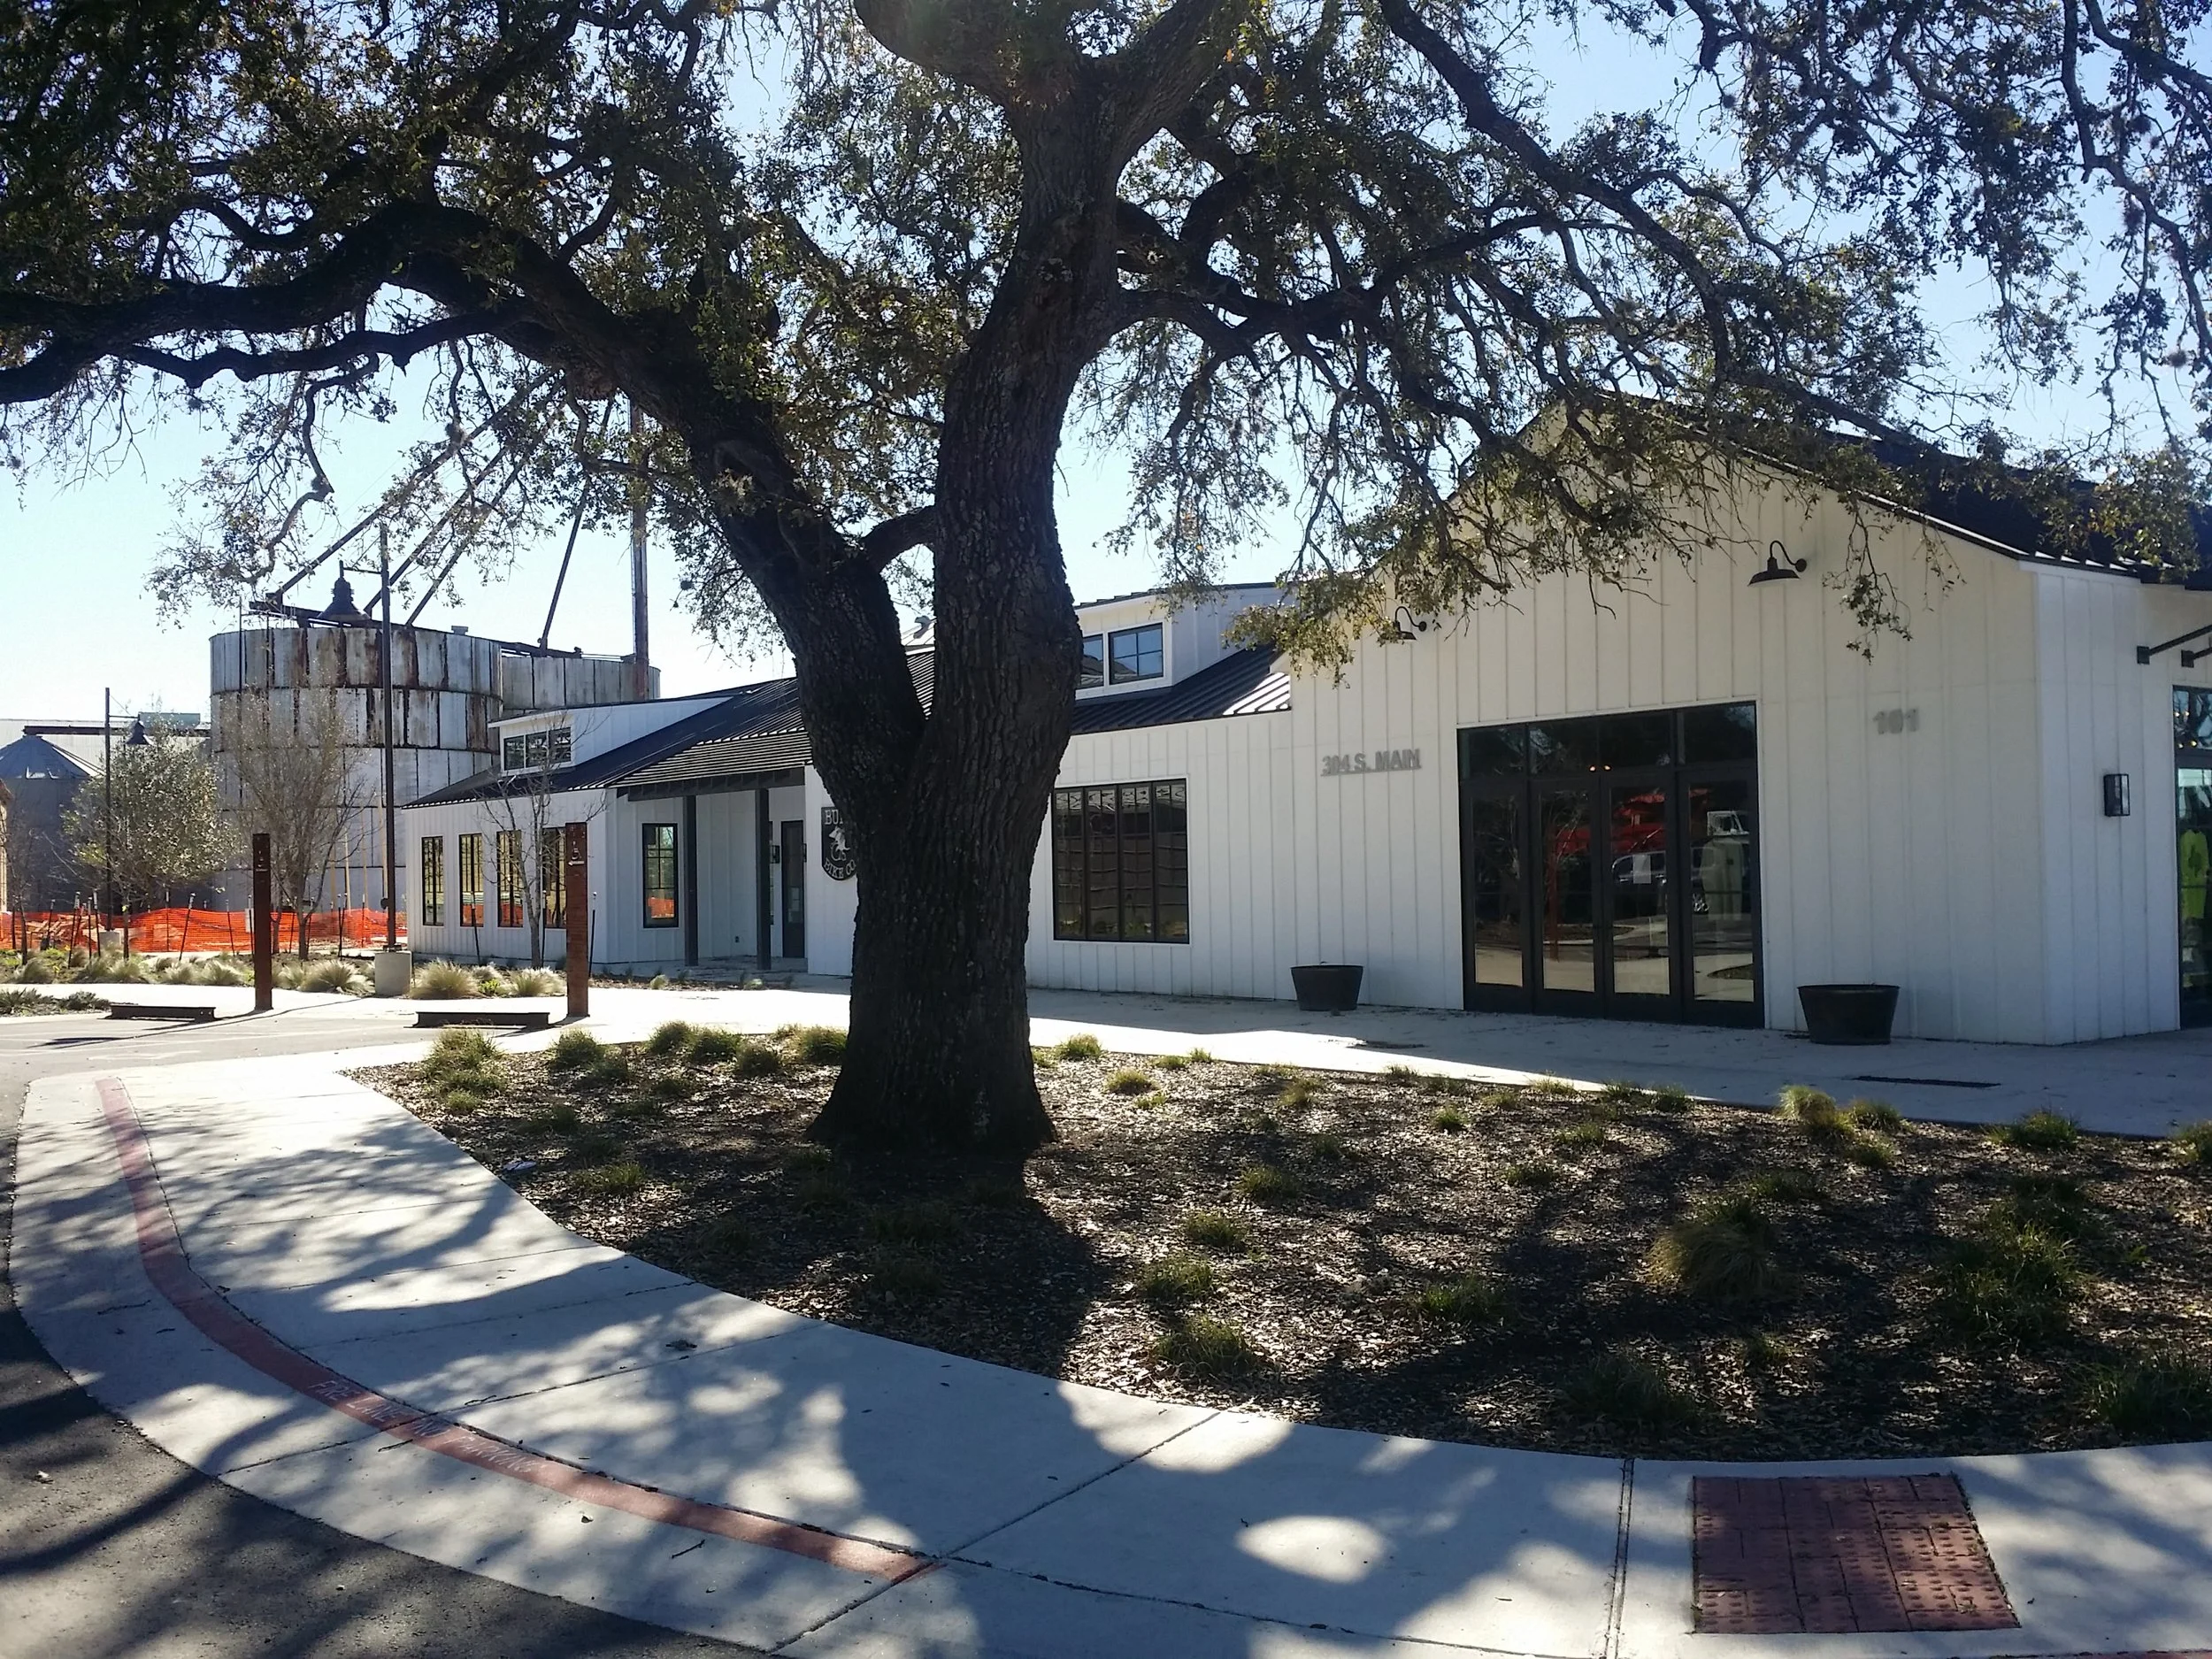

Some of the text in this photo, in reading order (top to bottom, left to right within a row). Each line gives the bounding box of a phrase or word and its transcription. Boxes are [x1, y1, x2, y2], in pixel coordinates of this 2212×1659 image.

[1375, 749, 1422, 772] MAIN
[824, 857, 844, 879] BIKE
[307, 1379, 361, 1401] FIRE
[346, 1396, 411, 1423] LANE
[443, 1435, 547, 1473] PARKING
